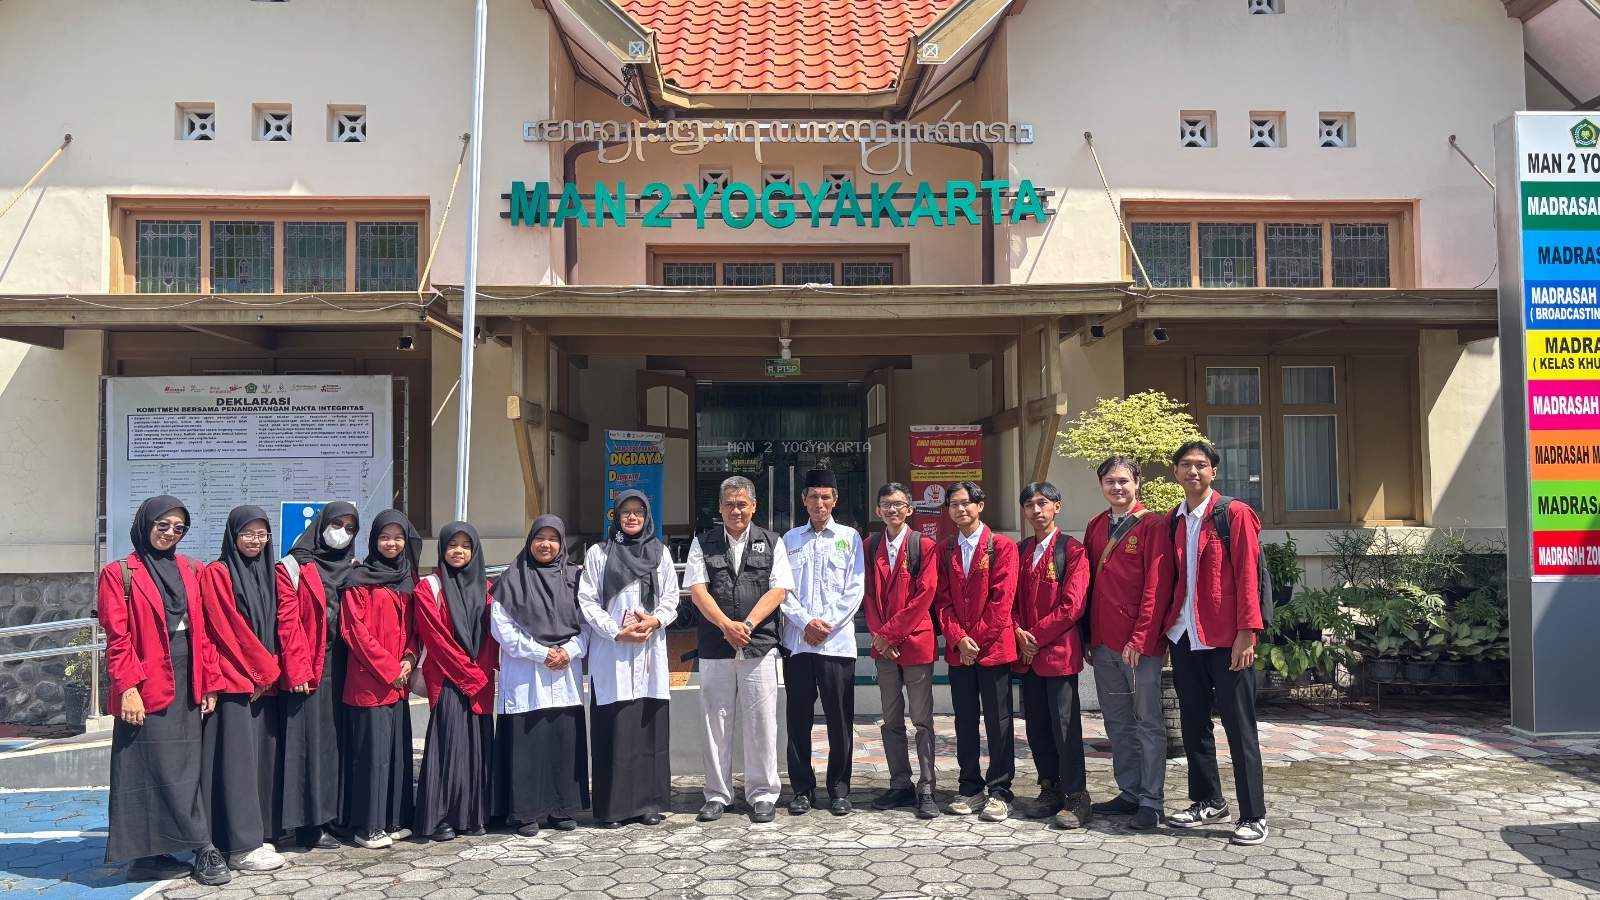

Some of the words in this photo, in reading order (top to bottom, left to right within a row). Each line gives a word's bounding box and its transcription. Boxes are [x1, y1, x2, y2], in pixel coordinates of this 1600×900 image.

[1527, 153, 1562, 173] MAN
[1567, 153, 1576, 173] 2
[510, 181, 628, 229] MAN
[642, 182, 674, 229] 2
[685, 179, 1048, 230] YOGYAKARTA
[1527, 196, 1600, 216] MADRASA
[1531, 287, 1597, 305] MADRASAH
[1540, 357, 1575, 370] KELAS
[1578, 357, 1600, 370] KHU
[216, 397, 291, 406] DEKLARASI
[1532, 395, 1600, 416] MADRASAH
[610, 452, 663, 466] DIGDAYA
[1535, 445, 1589, 464] MADRASAH
[1537, 495, 1600, 515] MADRAS
[1538, 546, 1584, 566] MADRASAH
